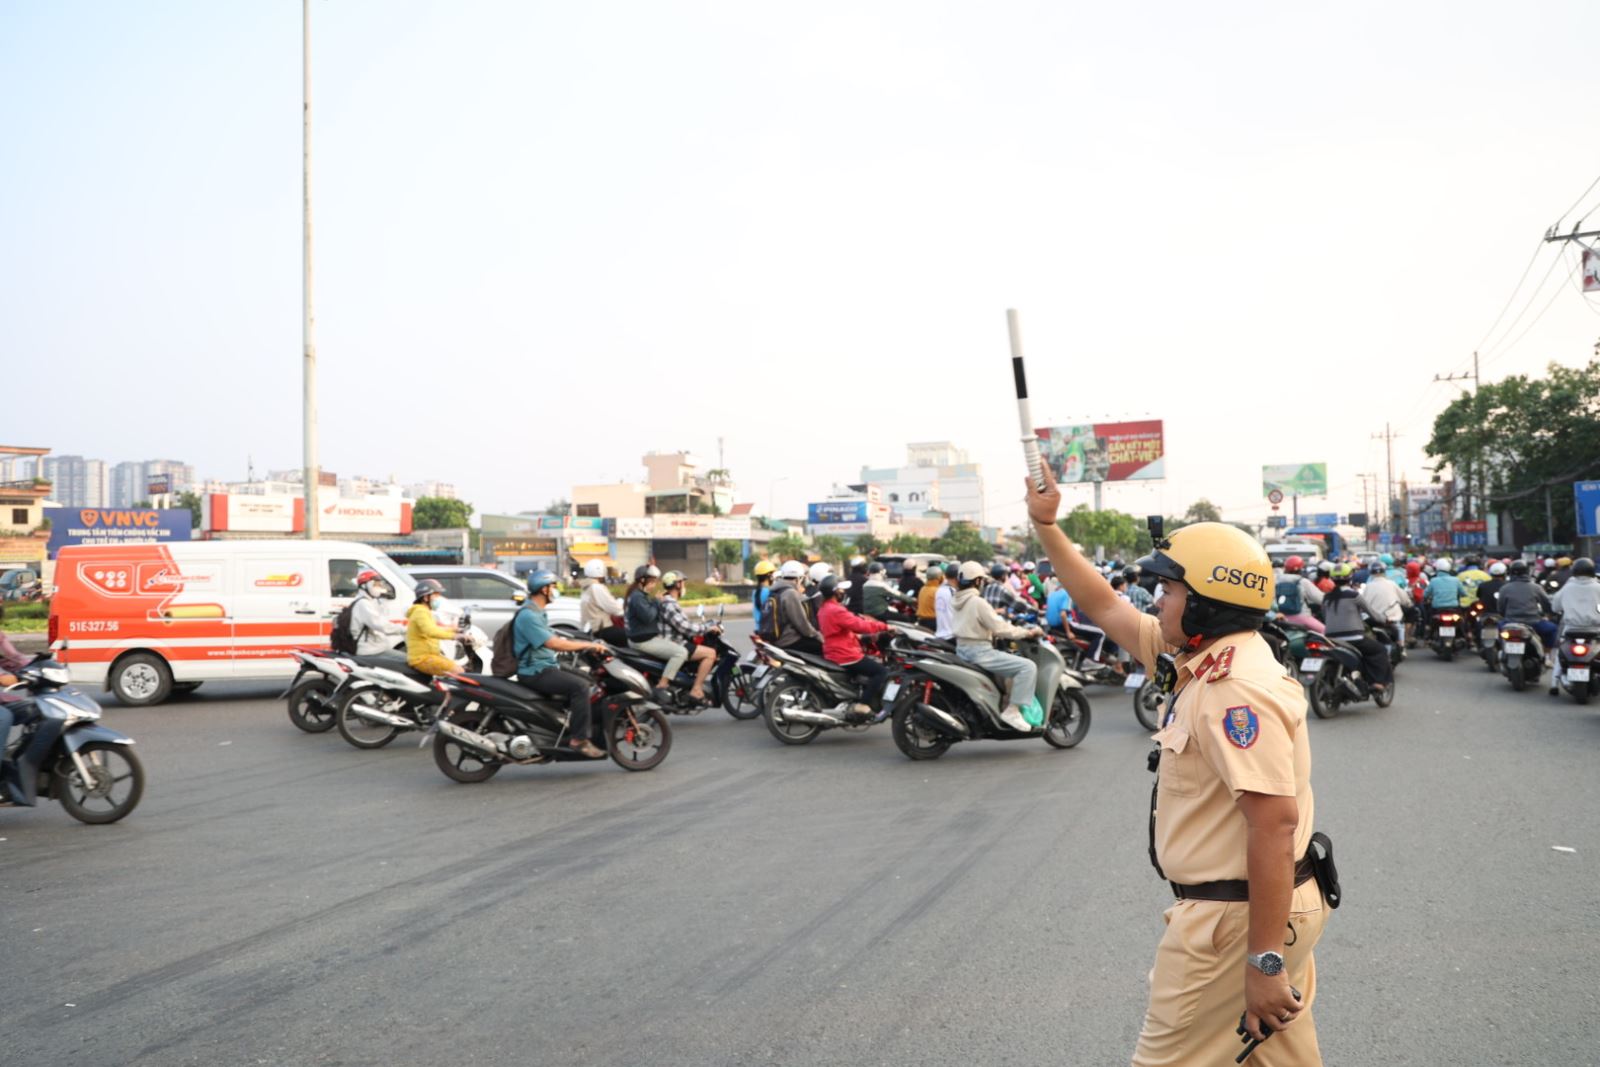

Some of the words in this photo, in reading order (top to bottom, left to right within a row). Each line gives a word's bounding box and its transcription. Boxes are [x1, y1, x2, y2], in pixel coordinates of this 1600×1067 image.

[338, 507, 384, 517] HONDA
[100, 511, 159, 527] VNVC
[1212, 565, 1268, 592] CSGT
[69, 621, 119, 632] 51E-327.56
